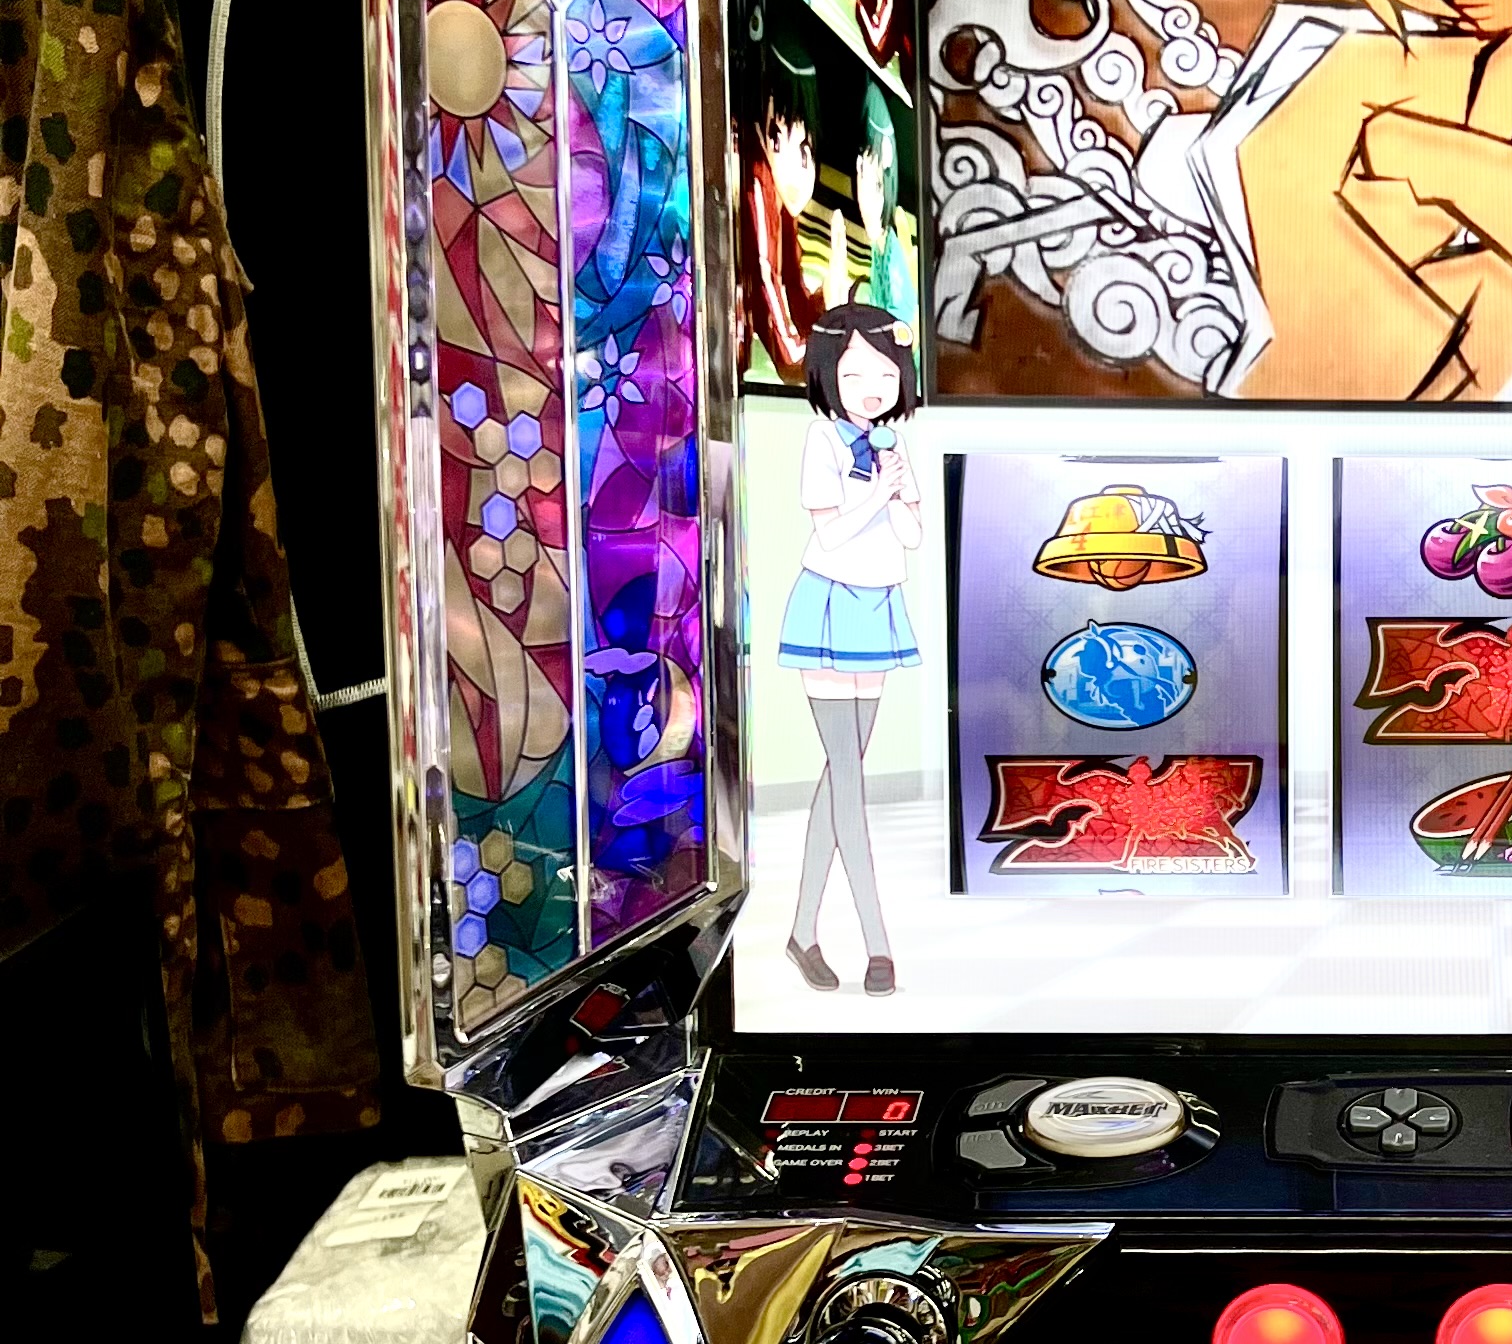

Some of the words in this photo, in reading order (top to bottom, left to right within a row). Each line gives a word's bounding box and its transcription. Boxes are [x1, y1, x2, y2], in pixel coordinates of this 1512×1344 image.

[1130, 858, 1171, 872] FIRE
[1173, 858, 1250, 872] SISTERS
[785, 1088, 836, 1096] CREDIT
[872, 1088, 899, 1096] WIN
[882, 1101, 911, 1120] 0
[878, 1129, 918, 1137] START
[777, 1144, 826, 1152] MEDALS
[829, 1144, 842, 1152] IN
[810, 1159, 843, 1167] OVER
